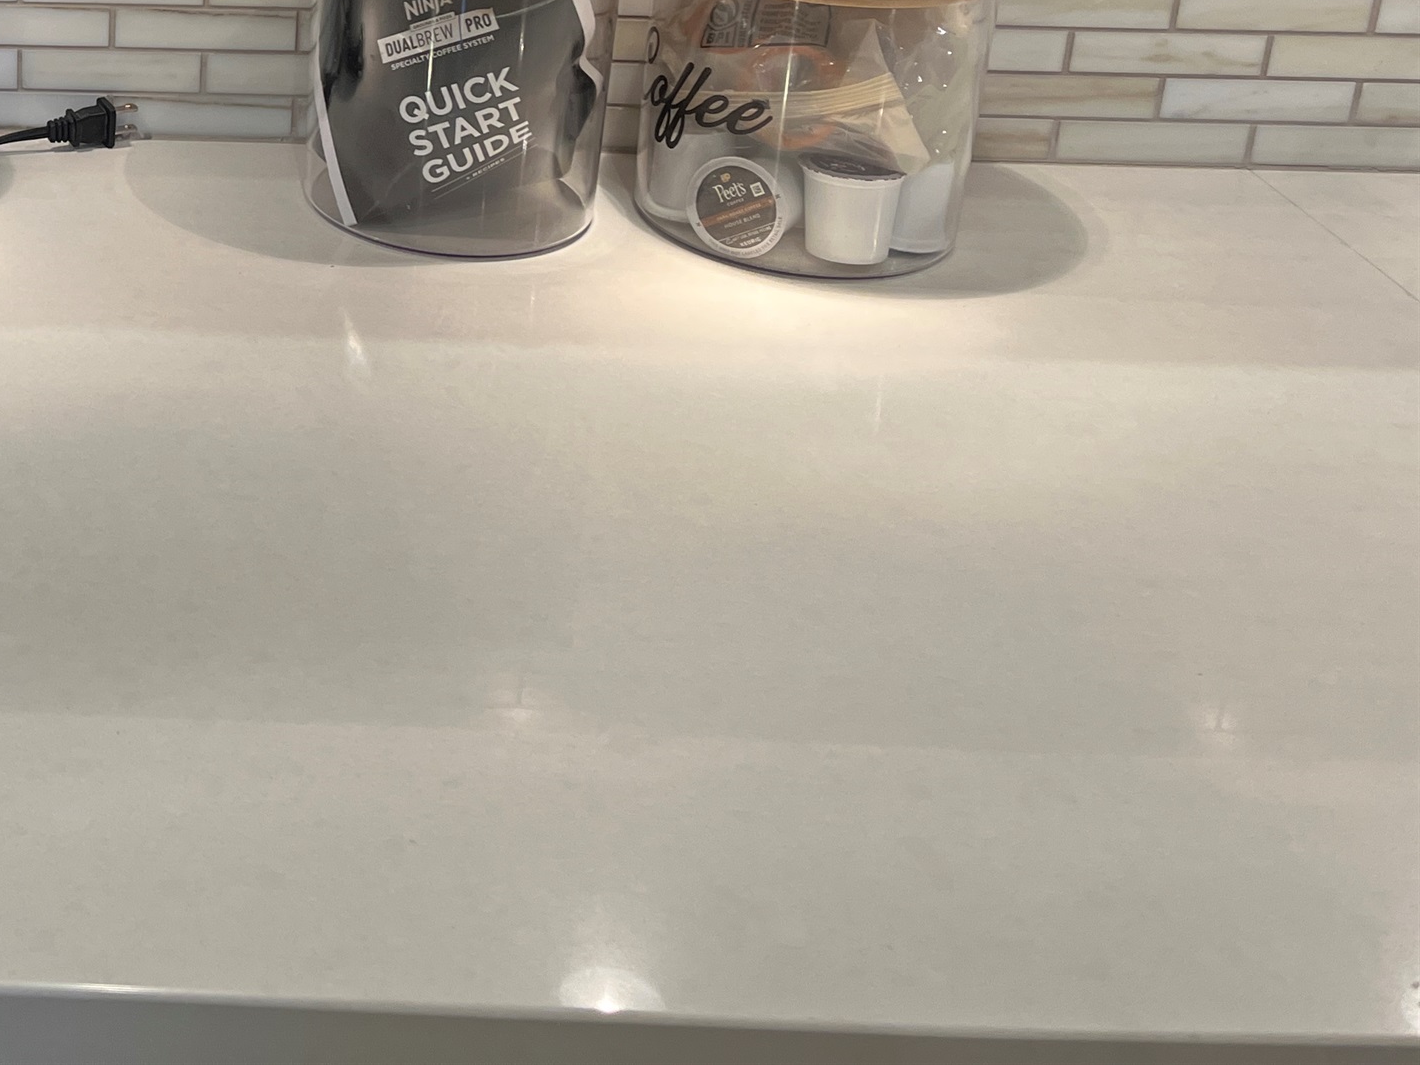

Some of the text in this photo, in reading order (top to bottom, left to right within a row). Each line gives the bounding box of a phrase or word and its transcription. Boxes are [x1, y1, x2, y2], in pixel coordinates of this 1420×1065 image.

[465, 13, 492, 33] PRO
[391, 35, 495, 71] SPECIALTY COFFEE SYSTEM
[399, 66, 520, 124] QUICK
[409, 96, 521, 156] START
[422, 120, 533, 184] GUIDE
[712, 182, 747, 203] Peet's
